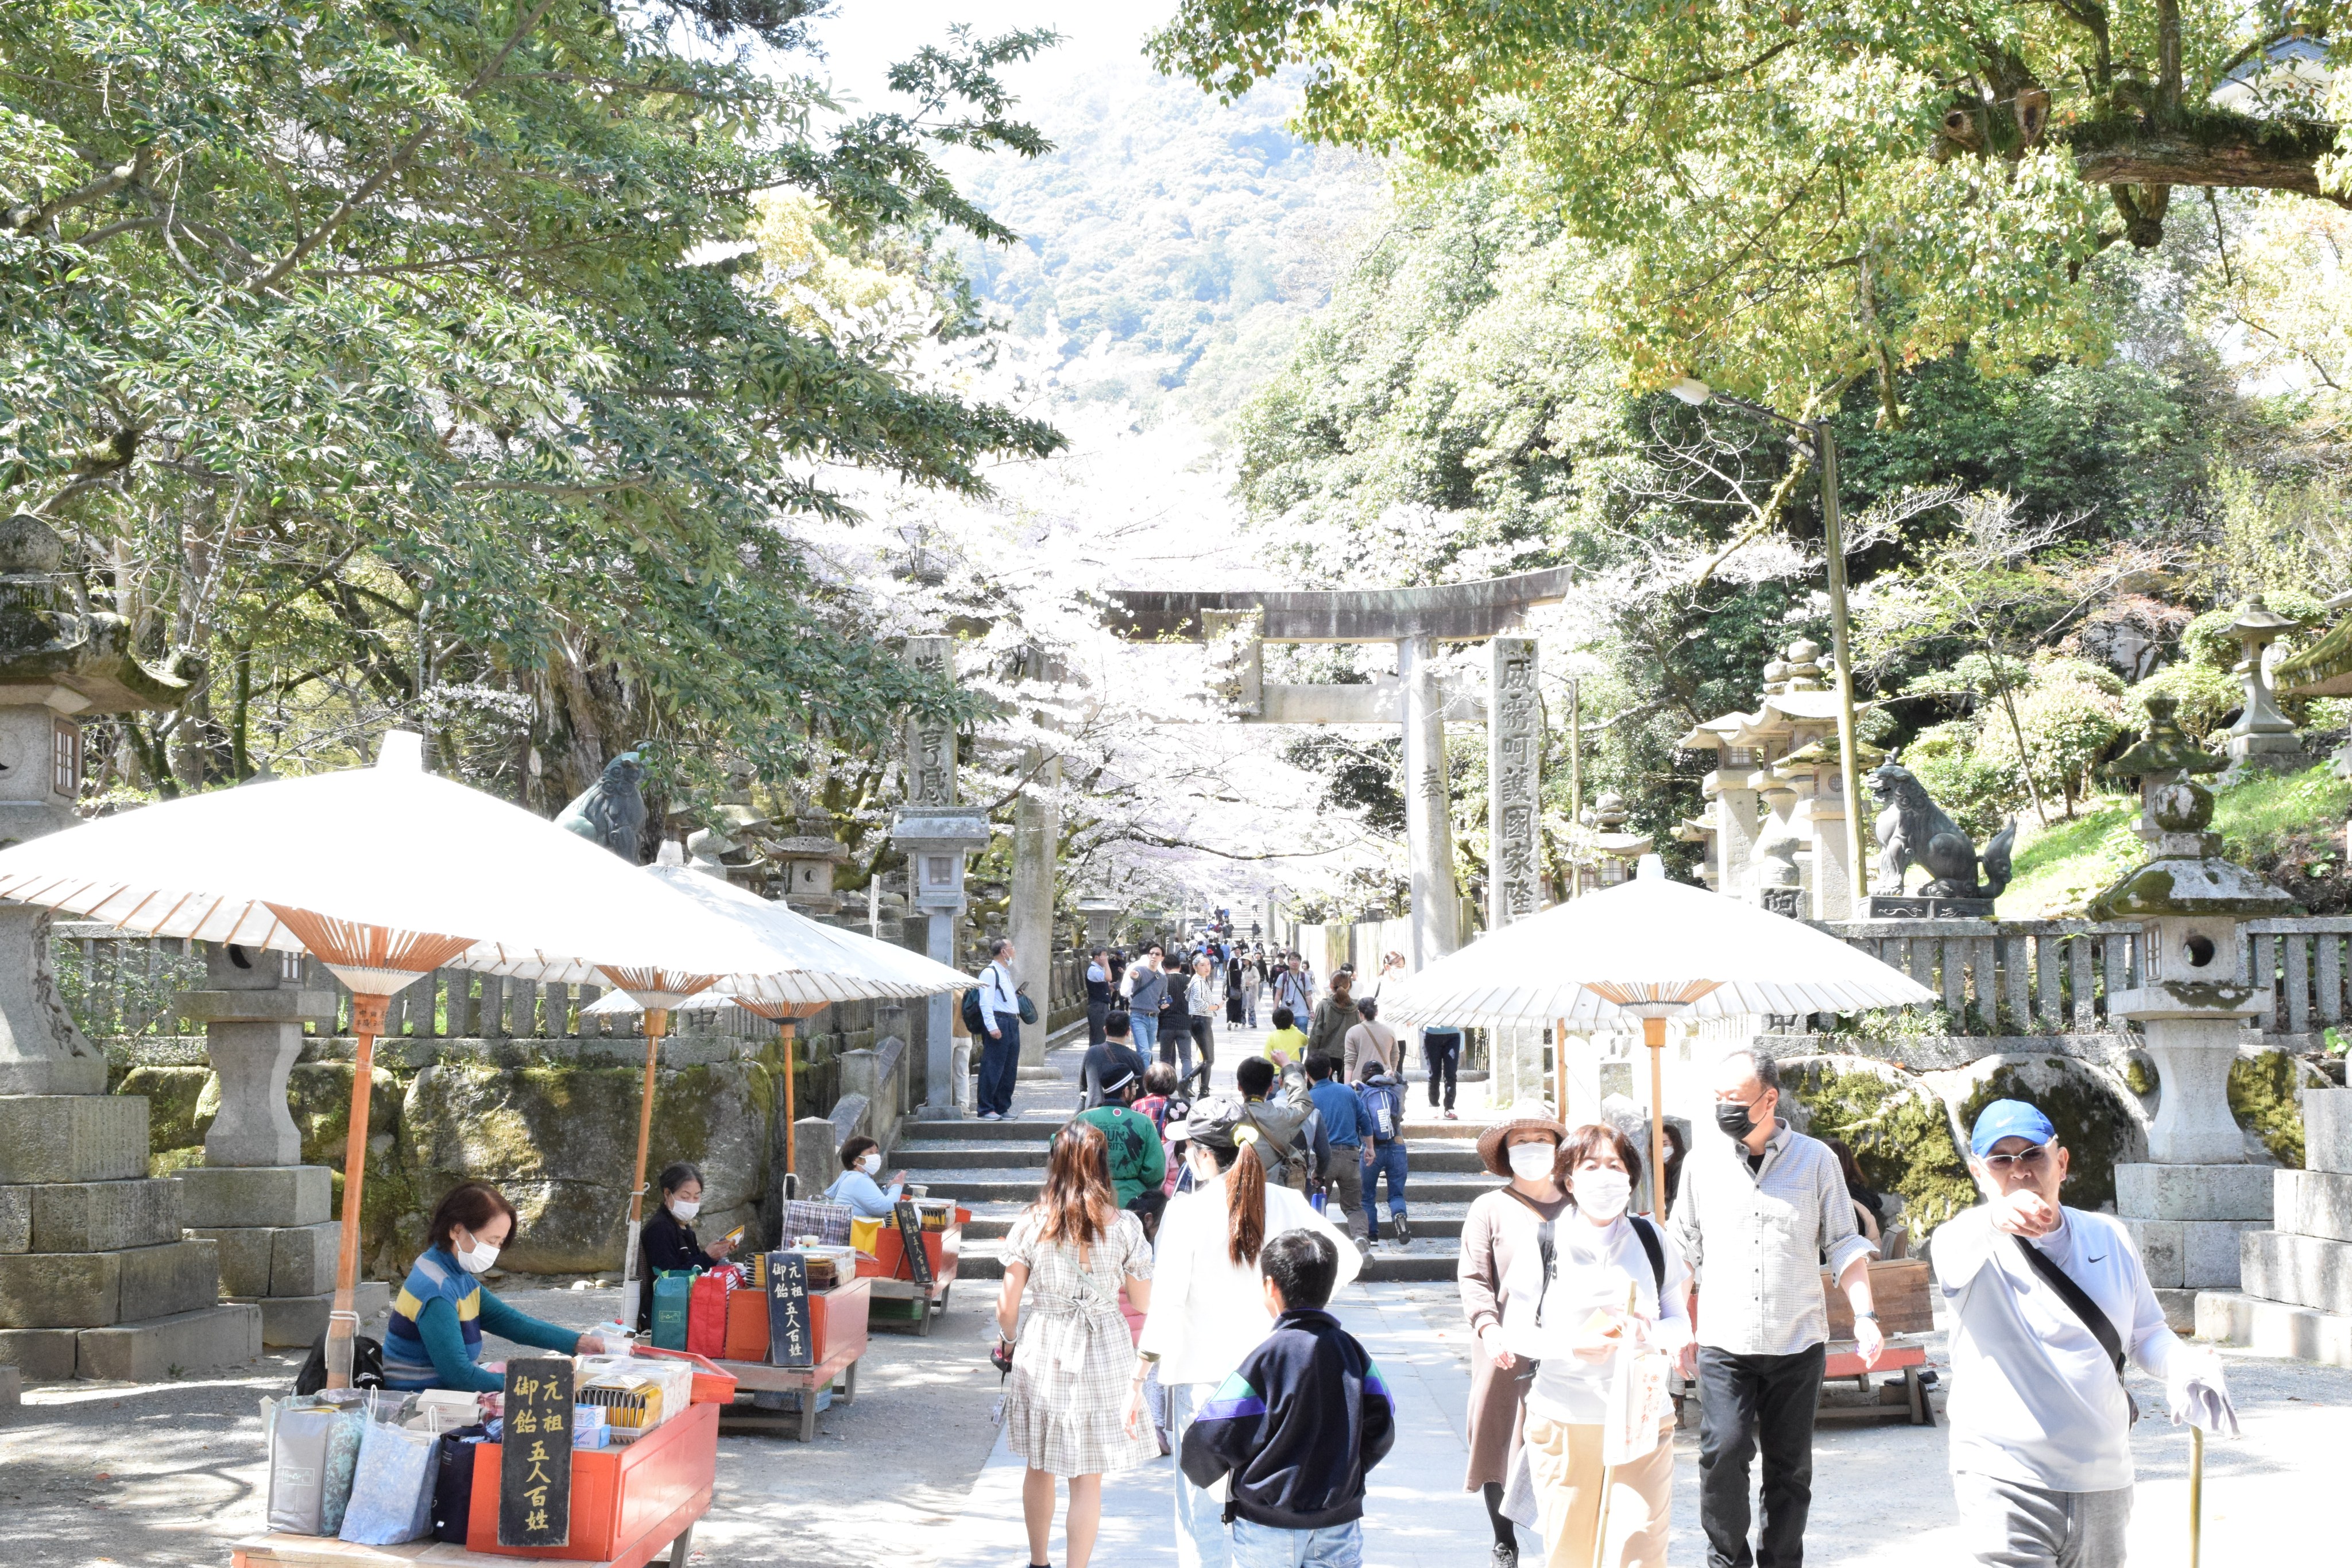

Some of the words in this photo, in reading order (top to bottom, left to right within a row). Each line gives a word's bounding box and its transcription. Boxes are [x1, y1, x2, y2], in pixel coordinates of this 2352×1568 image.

[1418, 765, 1444, 803] 奉
[1108, 1142, 1124, 1151] RITS
[908, 1207, 919, 1233] 元祖
[913, 1236, 928, 1275] 五人百姓
[772, 1263, 788, 1298] 御飴
[788, 1262, 804, 1298] 元祖
[785, 1302, 803, 1357] 五人百姓
[512, 1375, 539, 1434] 御飴
[543, 1375, 564, 1434] 元祖
[524, 1440, 552, 1532] 五人百姓
